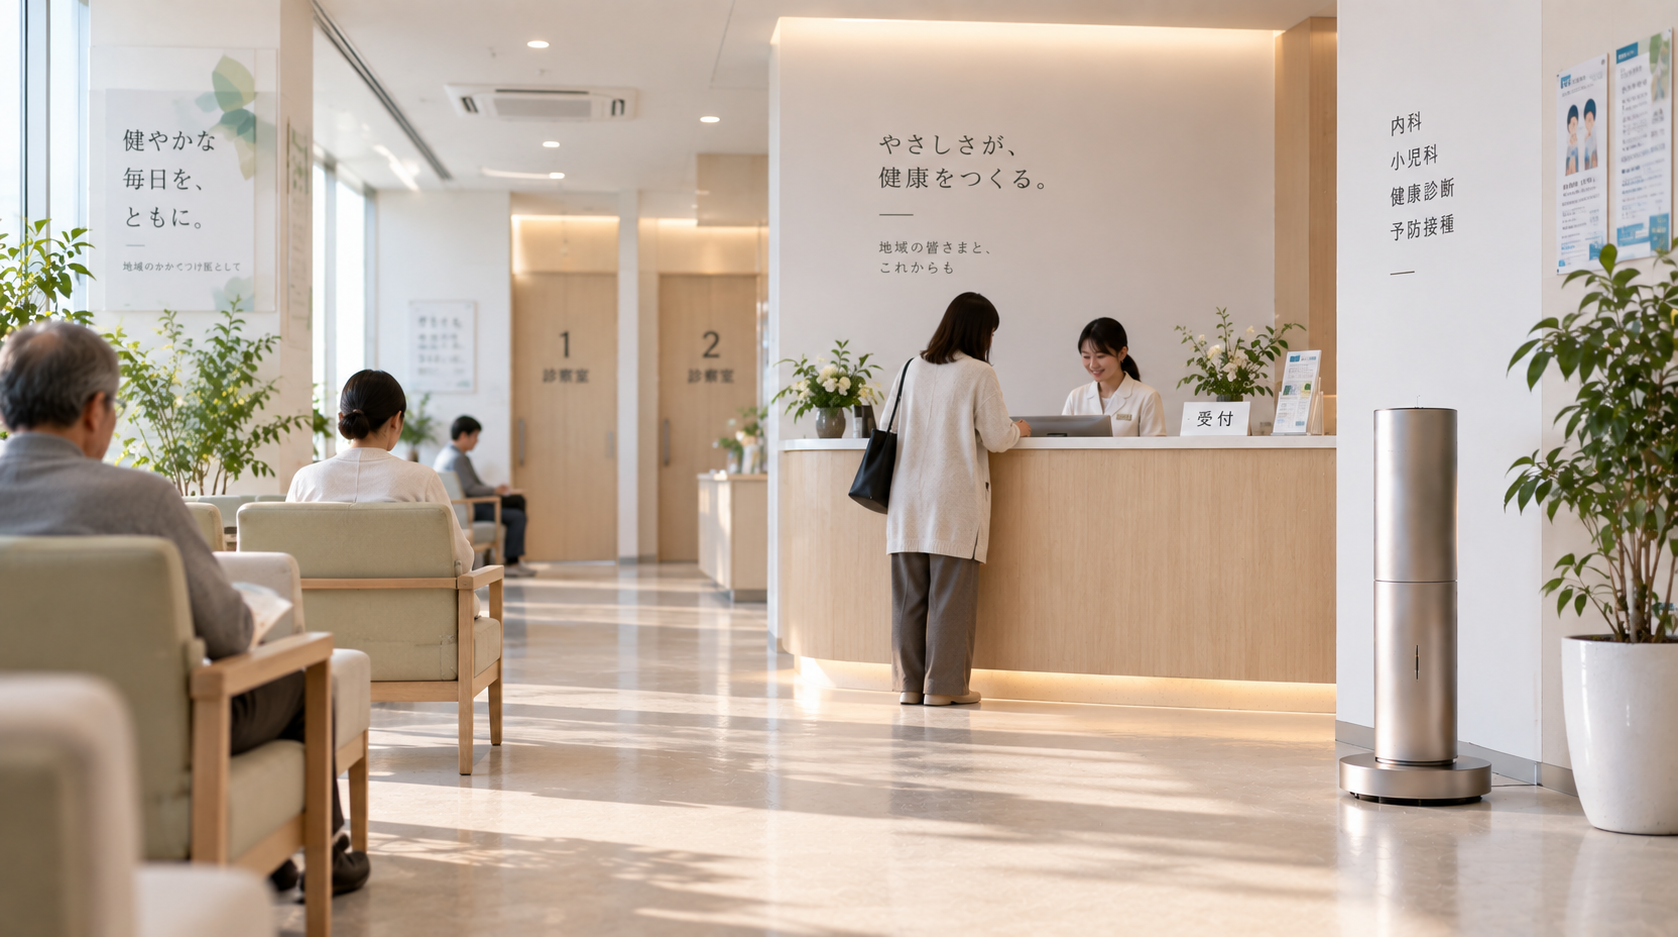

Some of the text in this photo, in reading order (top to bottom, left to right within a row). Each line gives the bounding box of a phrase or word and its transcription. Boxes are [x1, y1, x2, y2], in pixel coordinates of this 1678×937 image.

[1390, 110, 1422, 137] 内科
[122, 129, 216, 152] 健やかな
[879, 134, 1015, 156] やさしさが、
[1390, 143, 1438, 171] 小児科
[122, 167, 202, 191] 毎日を、
[878, 166, 1045, 190] 健康をつくる。
[1390, 177, 1455, 208] 健康診断
[125, 206, 202, 229] ともに。
[1390, 213, 1455, 242] 予防接種
[878, 240, 990, 255] 地域の皆さまと、
[880, 261, 954, 275] これからも
[559, 330, 570, 359] 1
[702, 330, 721, 359] 2
[542, 368, 590, 384] 診察室
[688, 368, 735, 384] 診察室
[1196, 410, 1234, 428] 受付
